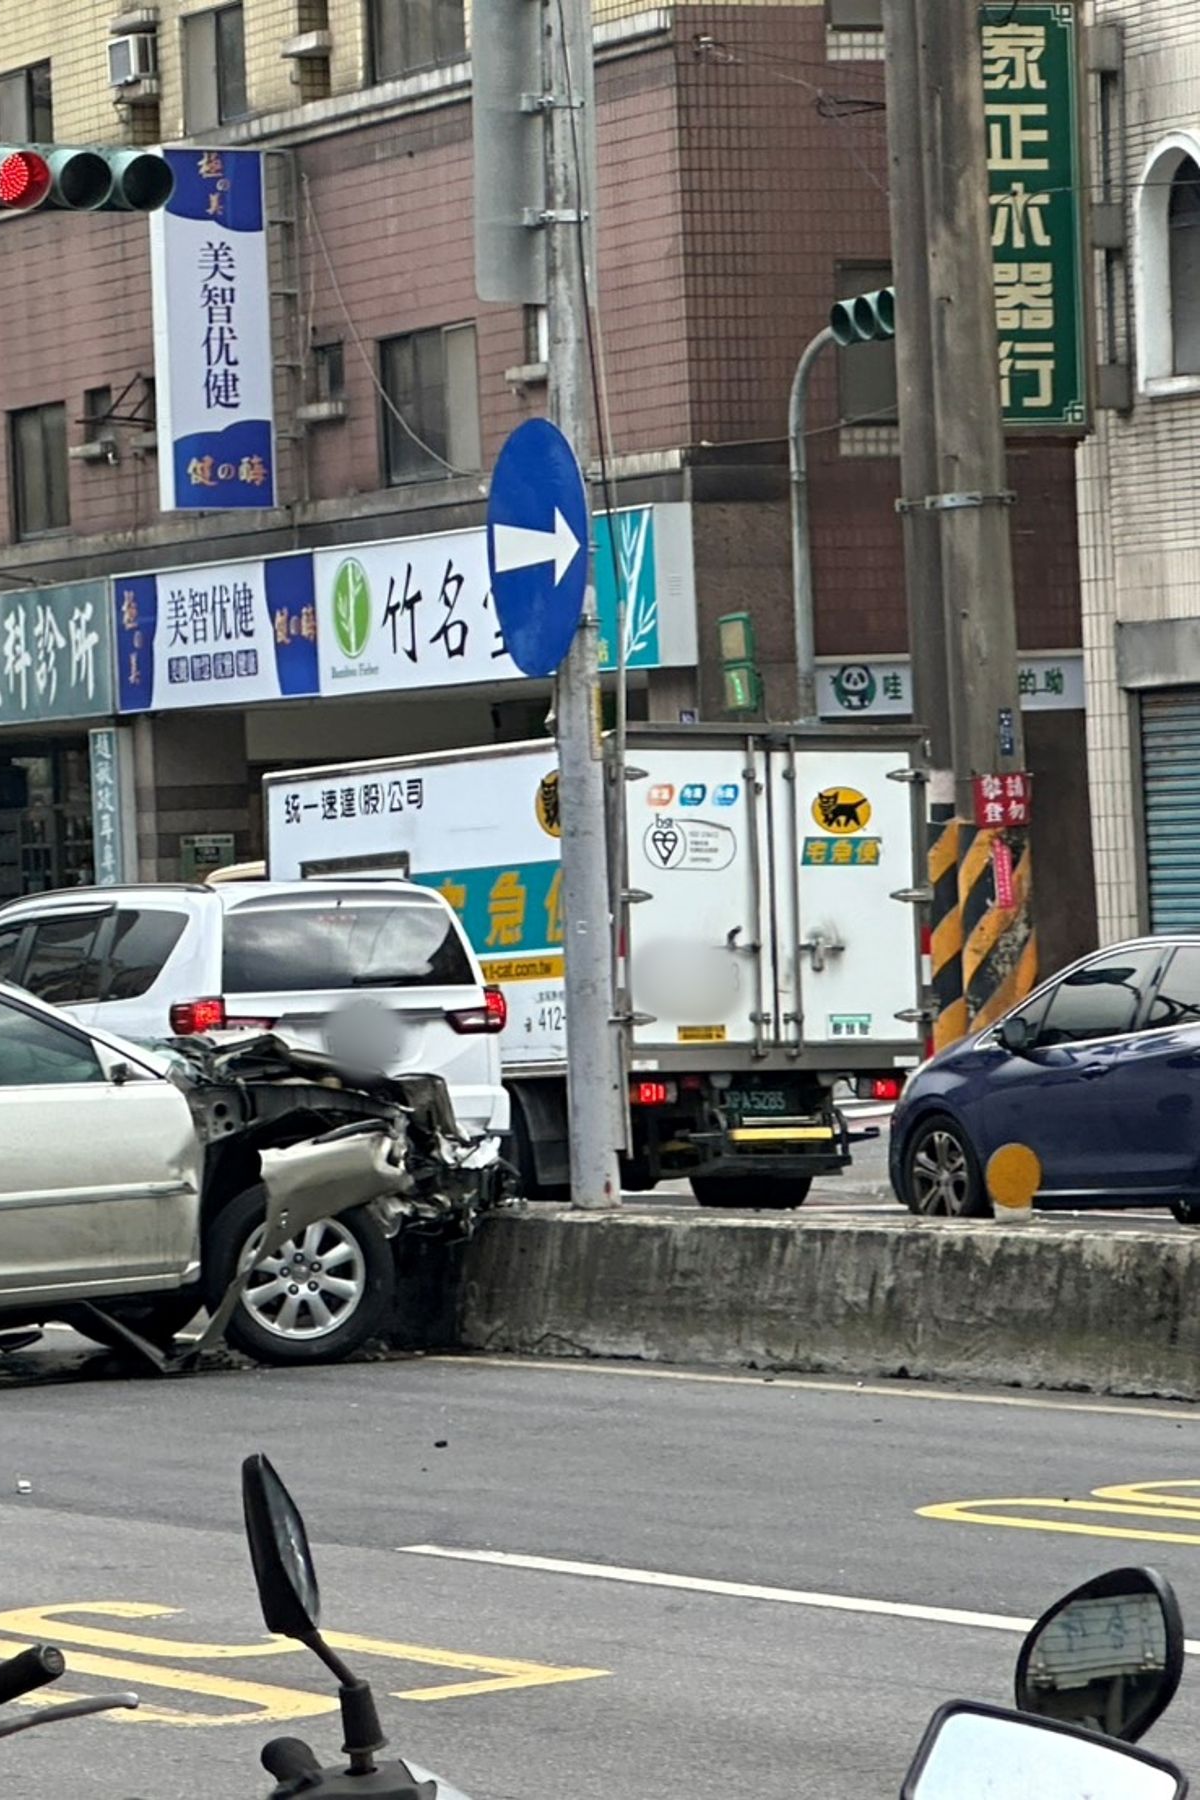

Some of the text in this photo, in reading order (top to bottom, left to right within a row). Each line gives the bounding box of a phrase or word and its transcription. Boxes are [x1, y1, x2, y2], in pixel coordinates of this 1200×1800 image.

[197, 241, 241, 410] 美智优健
[284, 778, 424, 824] 統一速達(股)公司
